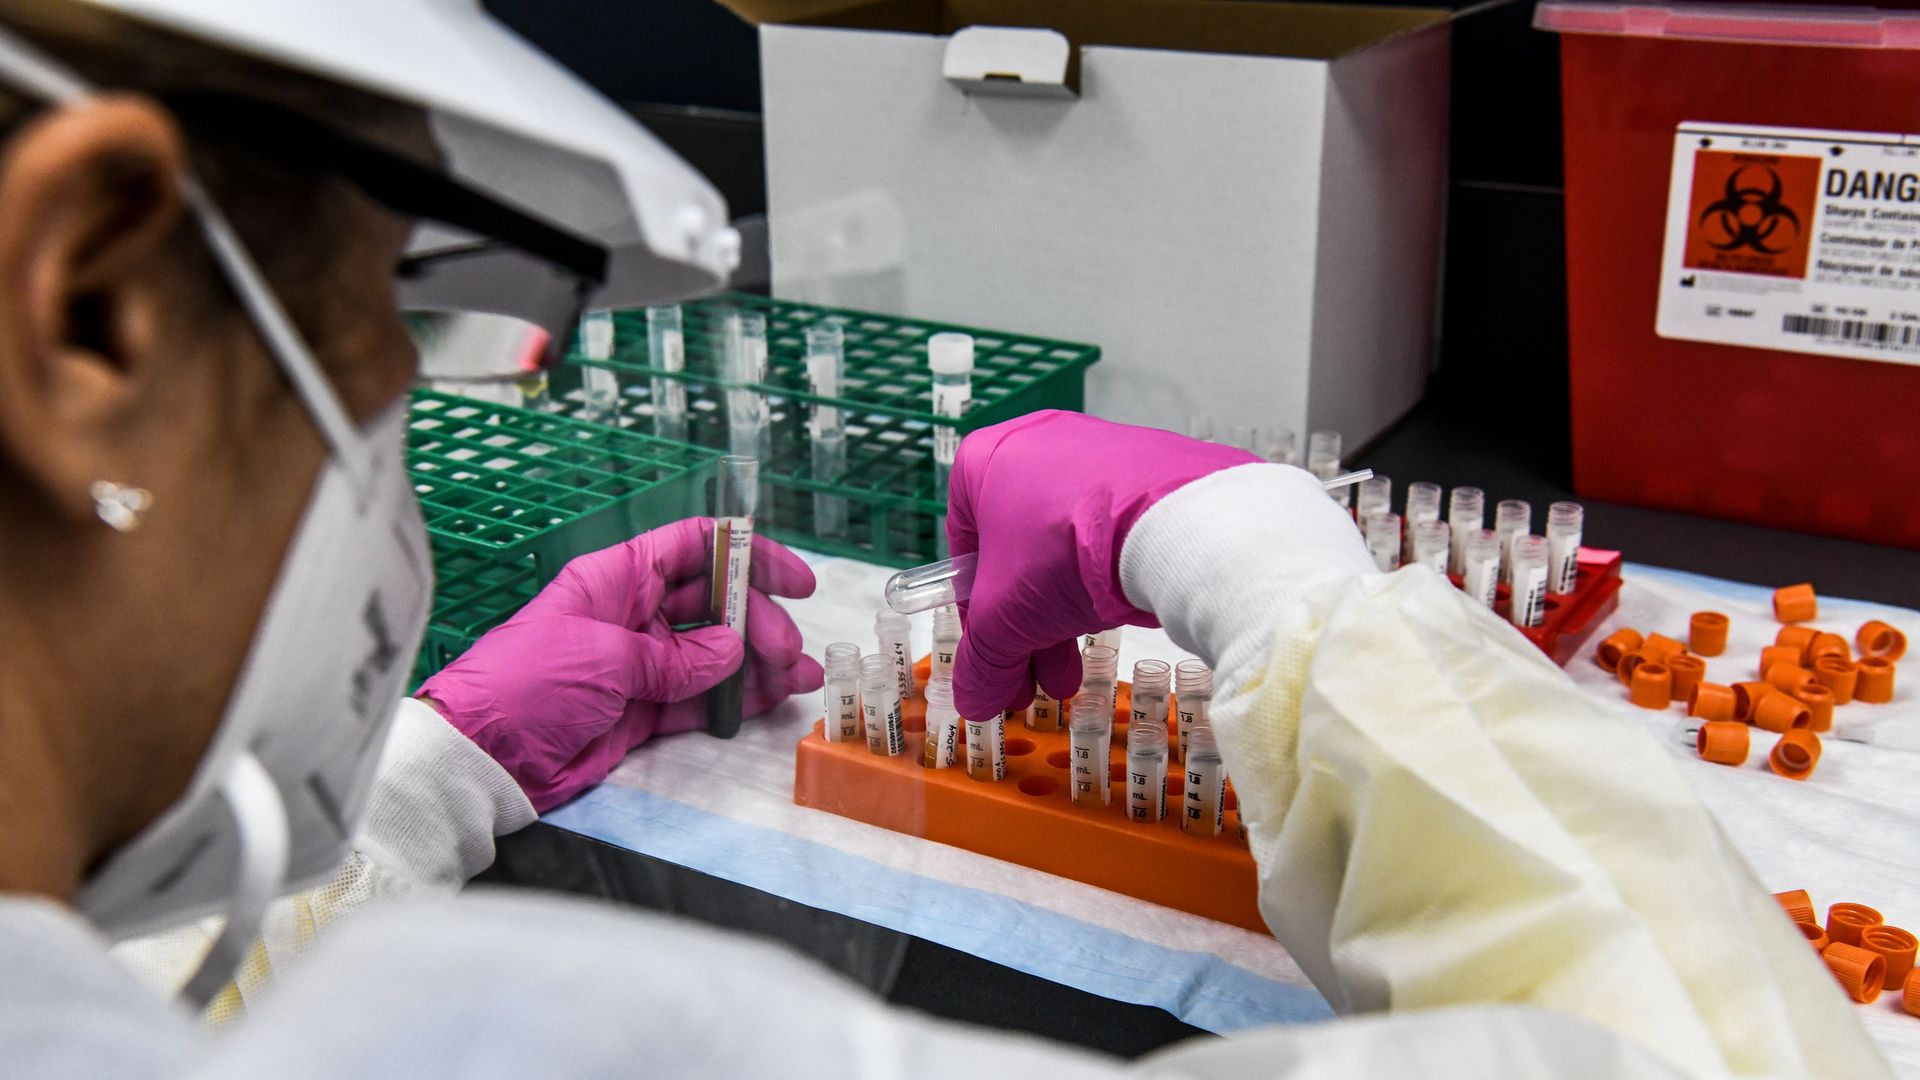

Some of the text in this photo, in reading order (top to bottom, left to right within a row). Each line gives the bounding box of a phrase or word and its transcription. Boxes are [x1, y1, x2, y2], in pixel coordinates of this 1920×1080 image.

[1825, 168, 1920, 203] DANG
[939, 656, 952, 664] 1.8
[842, 697, 854, 705] 1.8
[842, 712, 855, 720] mL
[1180, 714, 1192, 723] 1.8
[1076, 750, 1089, 759] 1.8
[1076, 766, 1091, 775] mL
[1132, 776, 1146, 786] 1.8
[1188, 774, 1201, 785] 1.8
[1133, 792, 1147, 801] mL
[1188, 792, 1201, 802] mL
